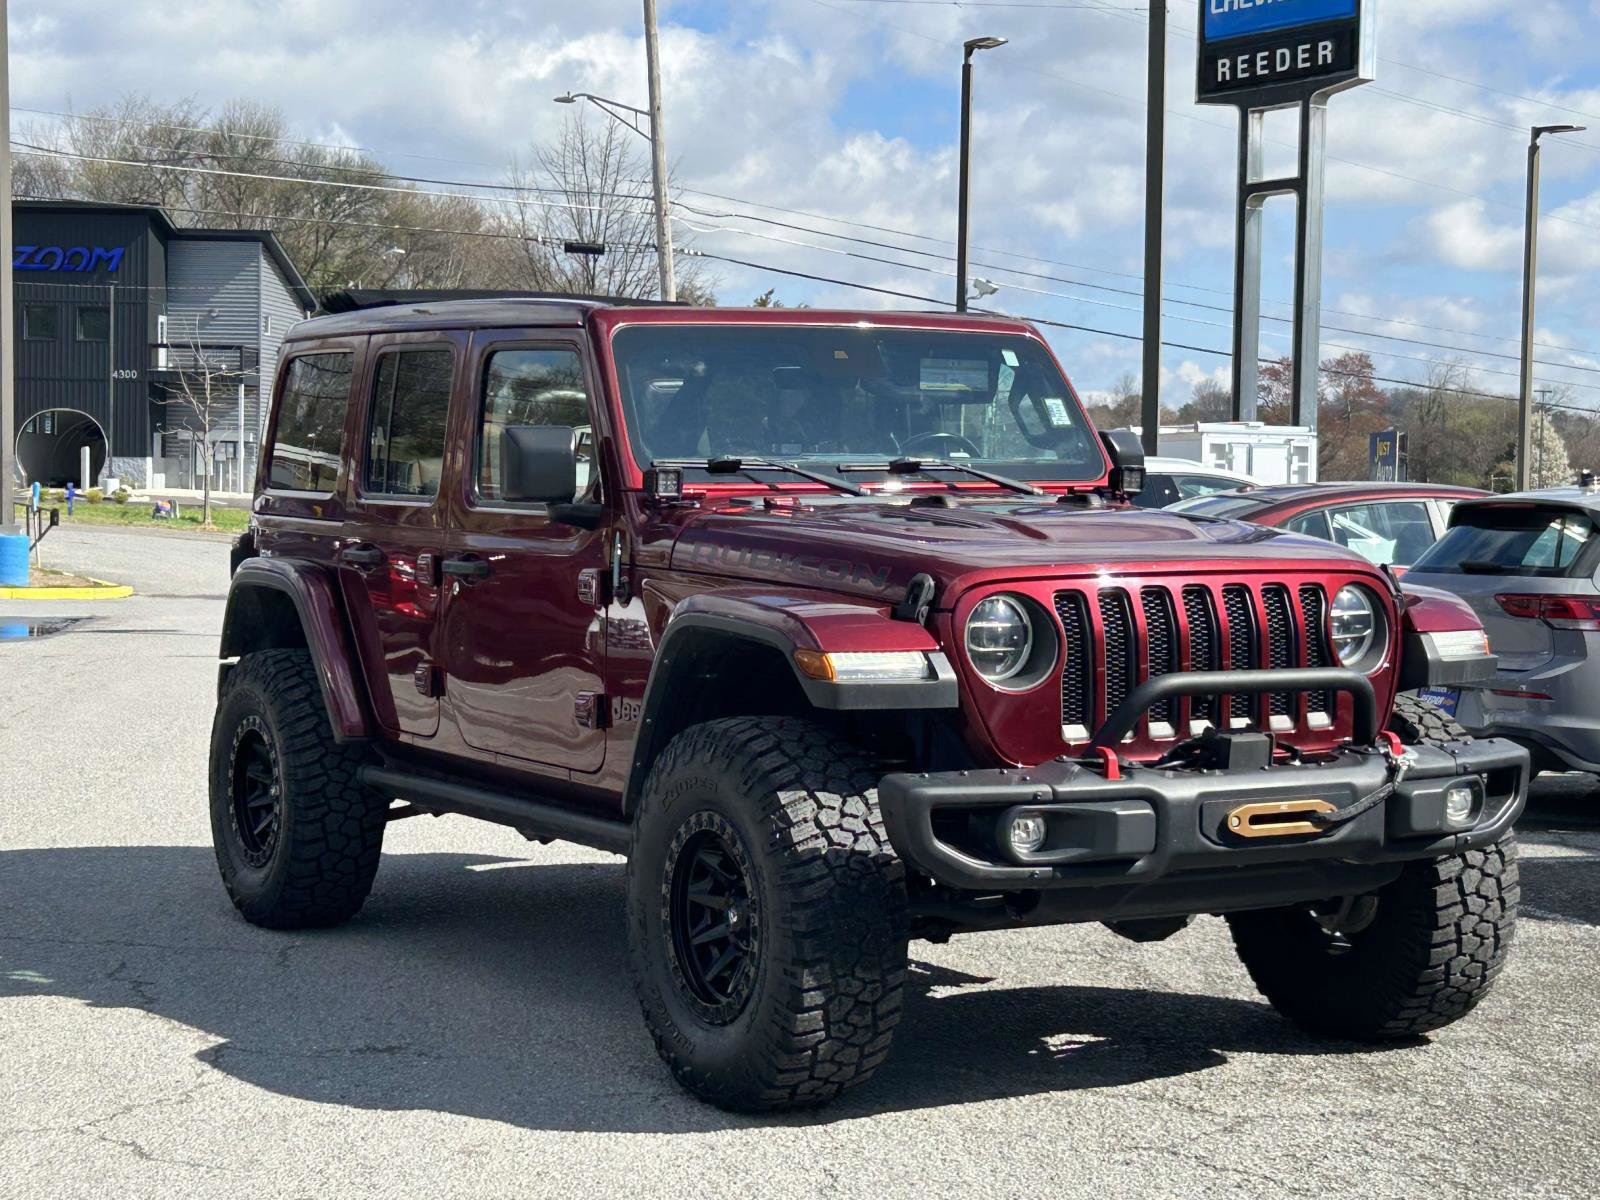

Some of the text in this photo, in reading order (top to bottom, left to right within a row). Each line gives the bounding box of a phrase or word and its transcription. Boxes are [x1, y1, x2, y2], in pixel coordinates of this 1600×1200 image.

[1217, 40, 1333, 82] REEDER
[13, 245, 125, 272] ZOOM
[112, 369, 138, 379] 4300
[692, 541, 892, 588] RUBICON
